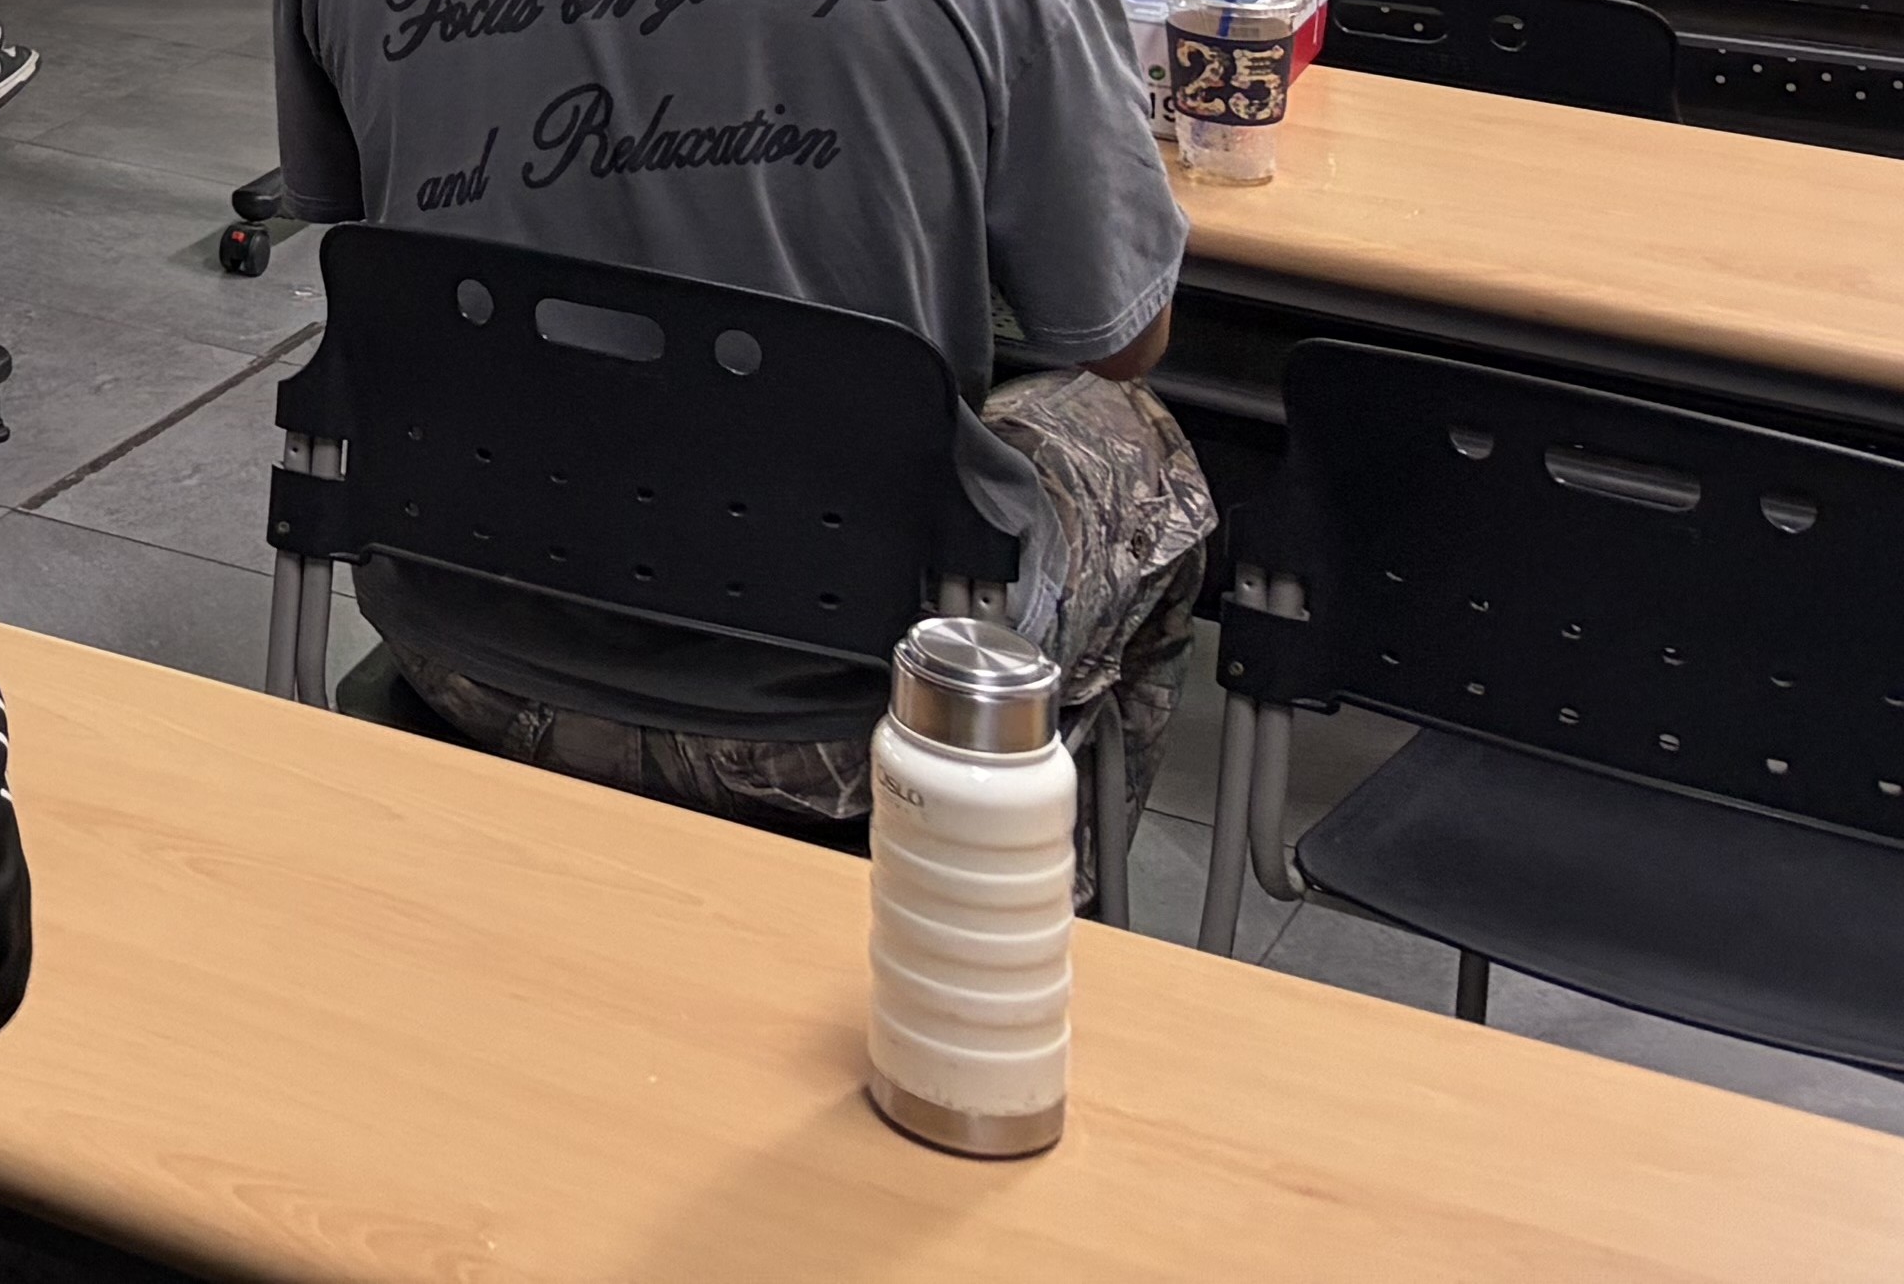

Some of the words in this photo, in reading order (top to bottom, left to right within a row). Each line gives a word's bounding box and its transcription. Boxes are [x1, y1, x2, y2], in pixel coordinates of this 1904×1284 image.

[1176, 38, 1285, 121] 25
[417, 128, 499, 213] and
[522, 81, 843, 190] Relaxation
